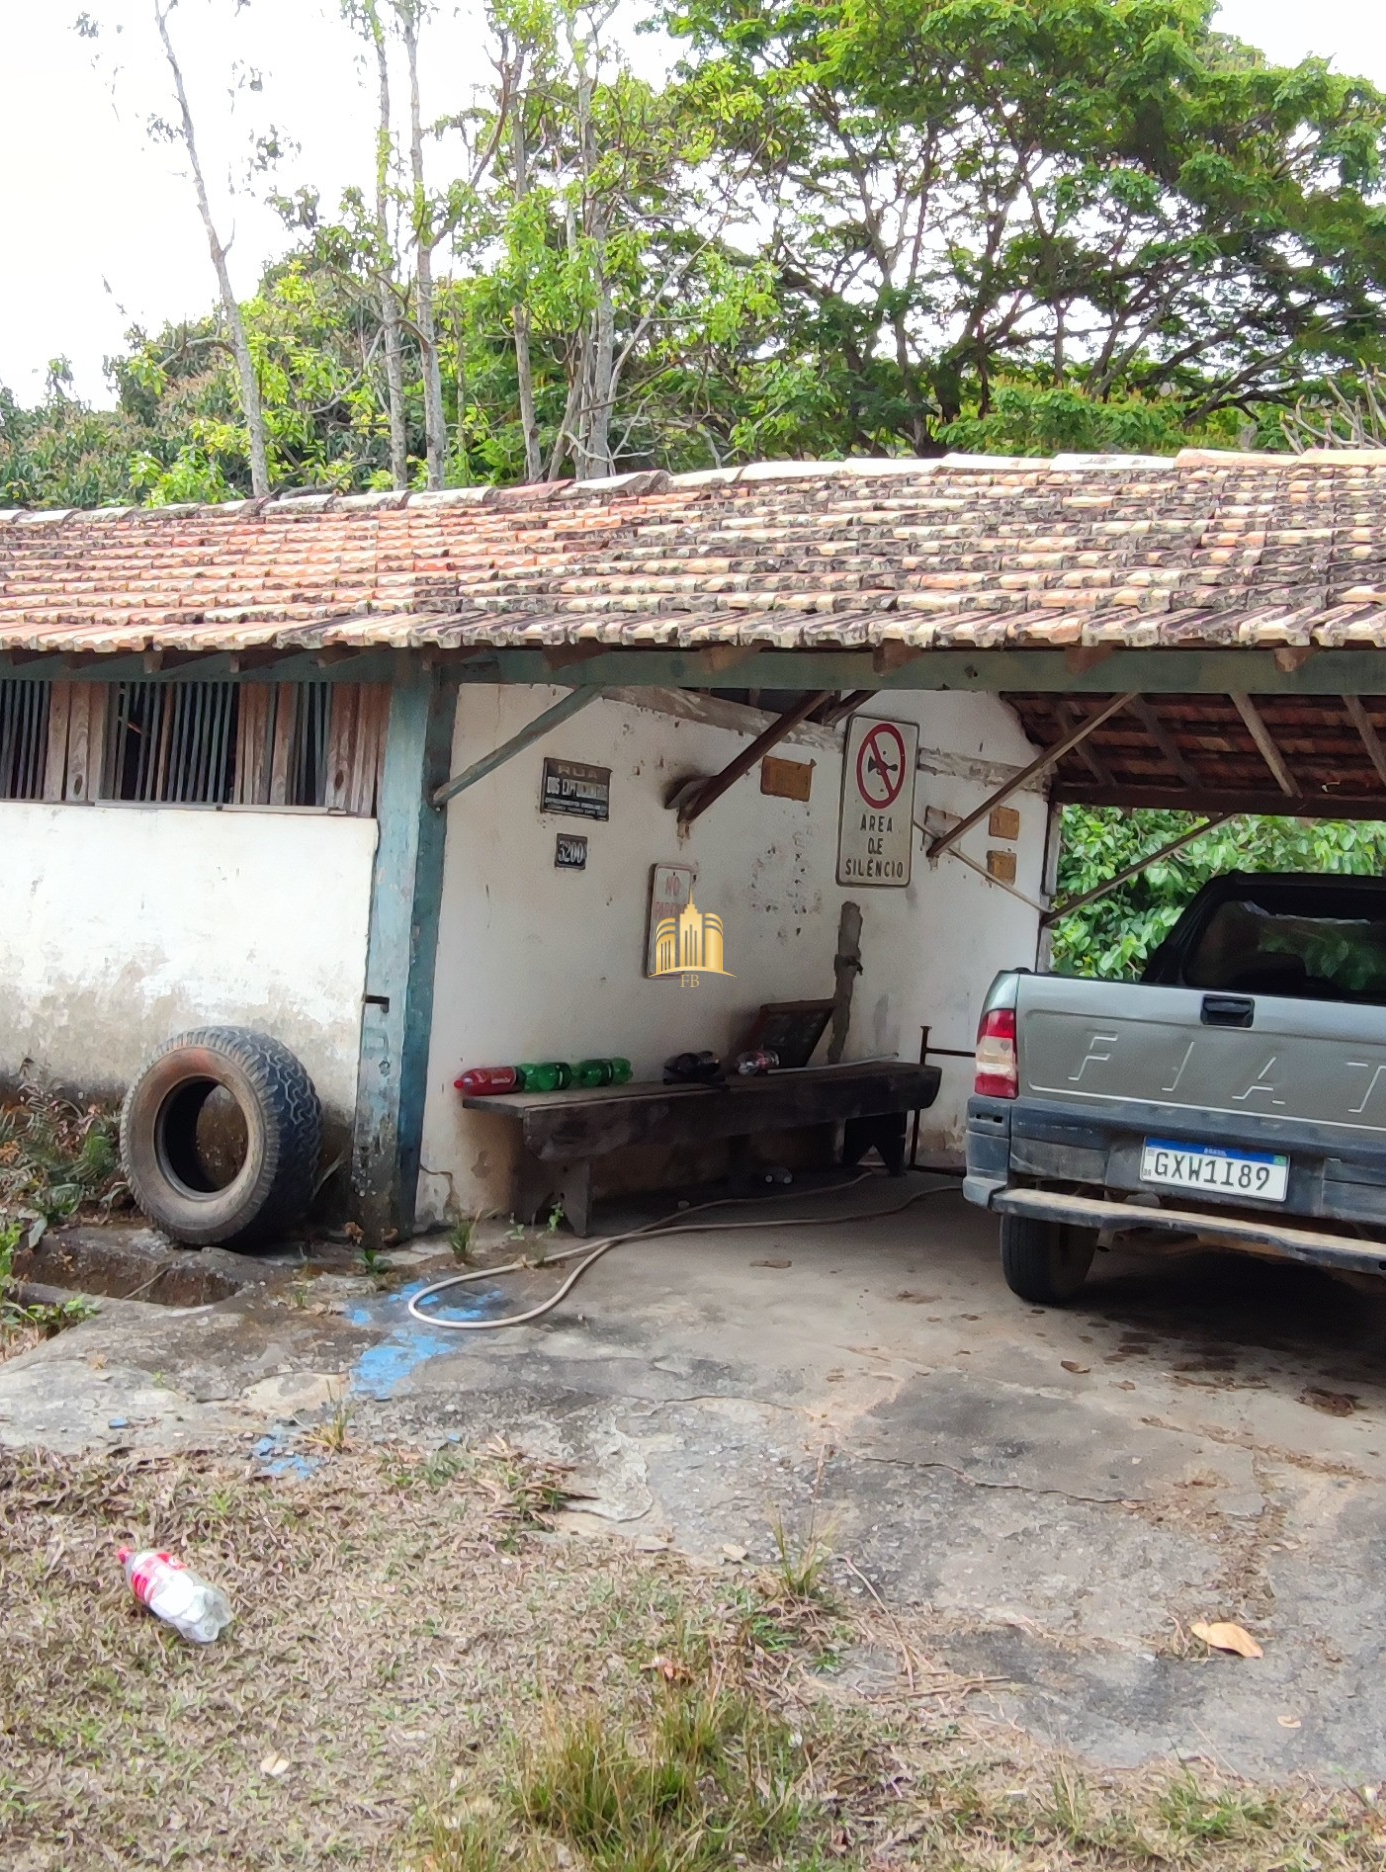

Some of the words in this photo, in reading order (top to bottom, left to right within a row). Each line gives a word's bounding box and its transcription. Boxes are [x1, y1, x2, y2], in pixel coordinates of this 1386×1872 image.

[557, 765, 598, 779] RUA
[868, 837, 884, 855] DE
[1154, 1151, 1270, 1191] GXW1I89
